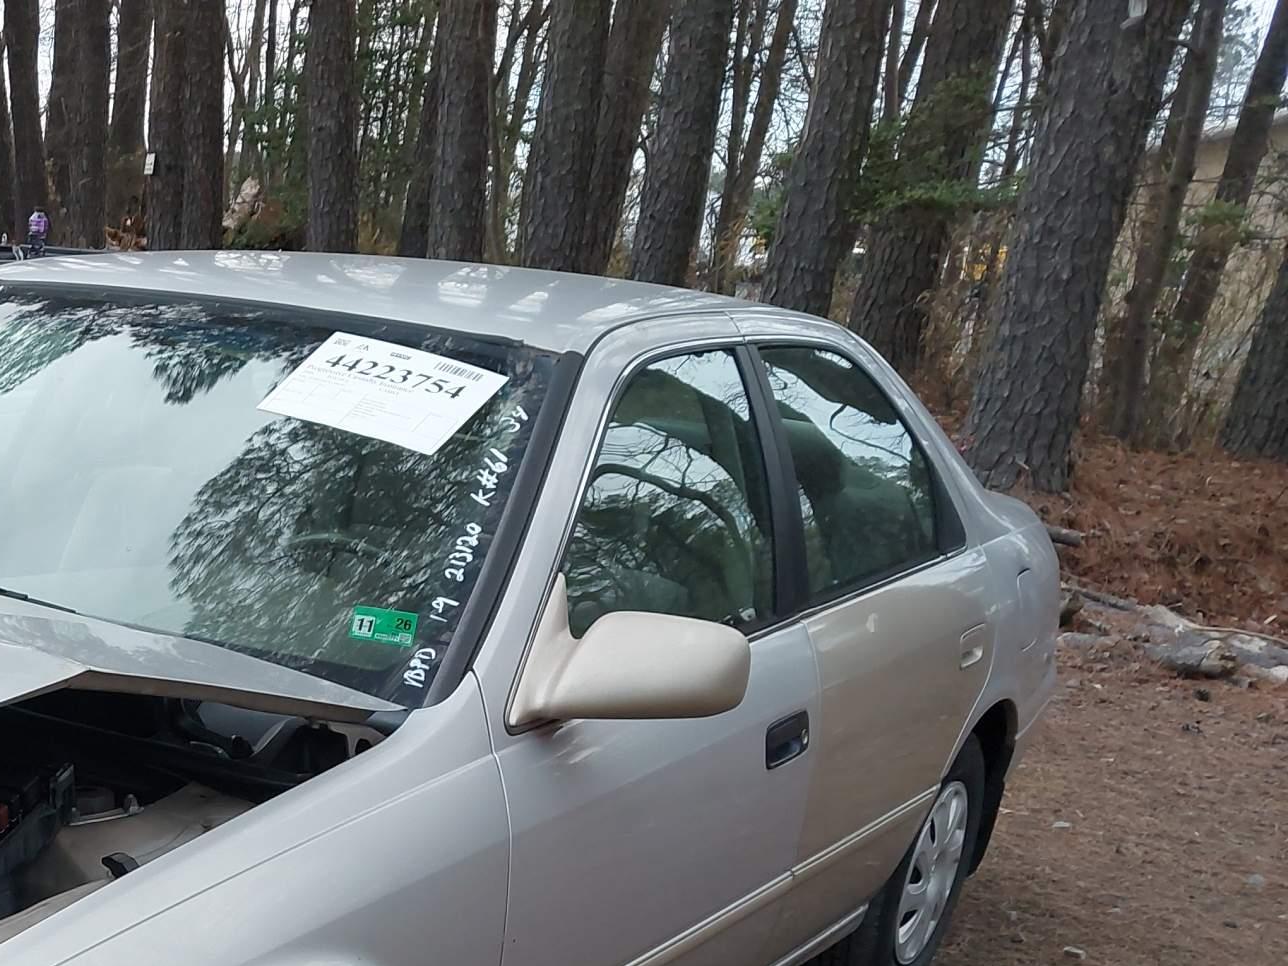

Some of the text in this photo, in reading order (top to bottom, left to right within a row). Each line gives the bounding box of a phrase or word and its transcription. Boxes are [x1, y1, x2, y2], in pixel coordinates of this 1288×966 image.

[324, 354, 467, 399] 44223754
[429, 597, 460, 623] 19
[357, 618, 412, 633] 11 26
